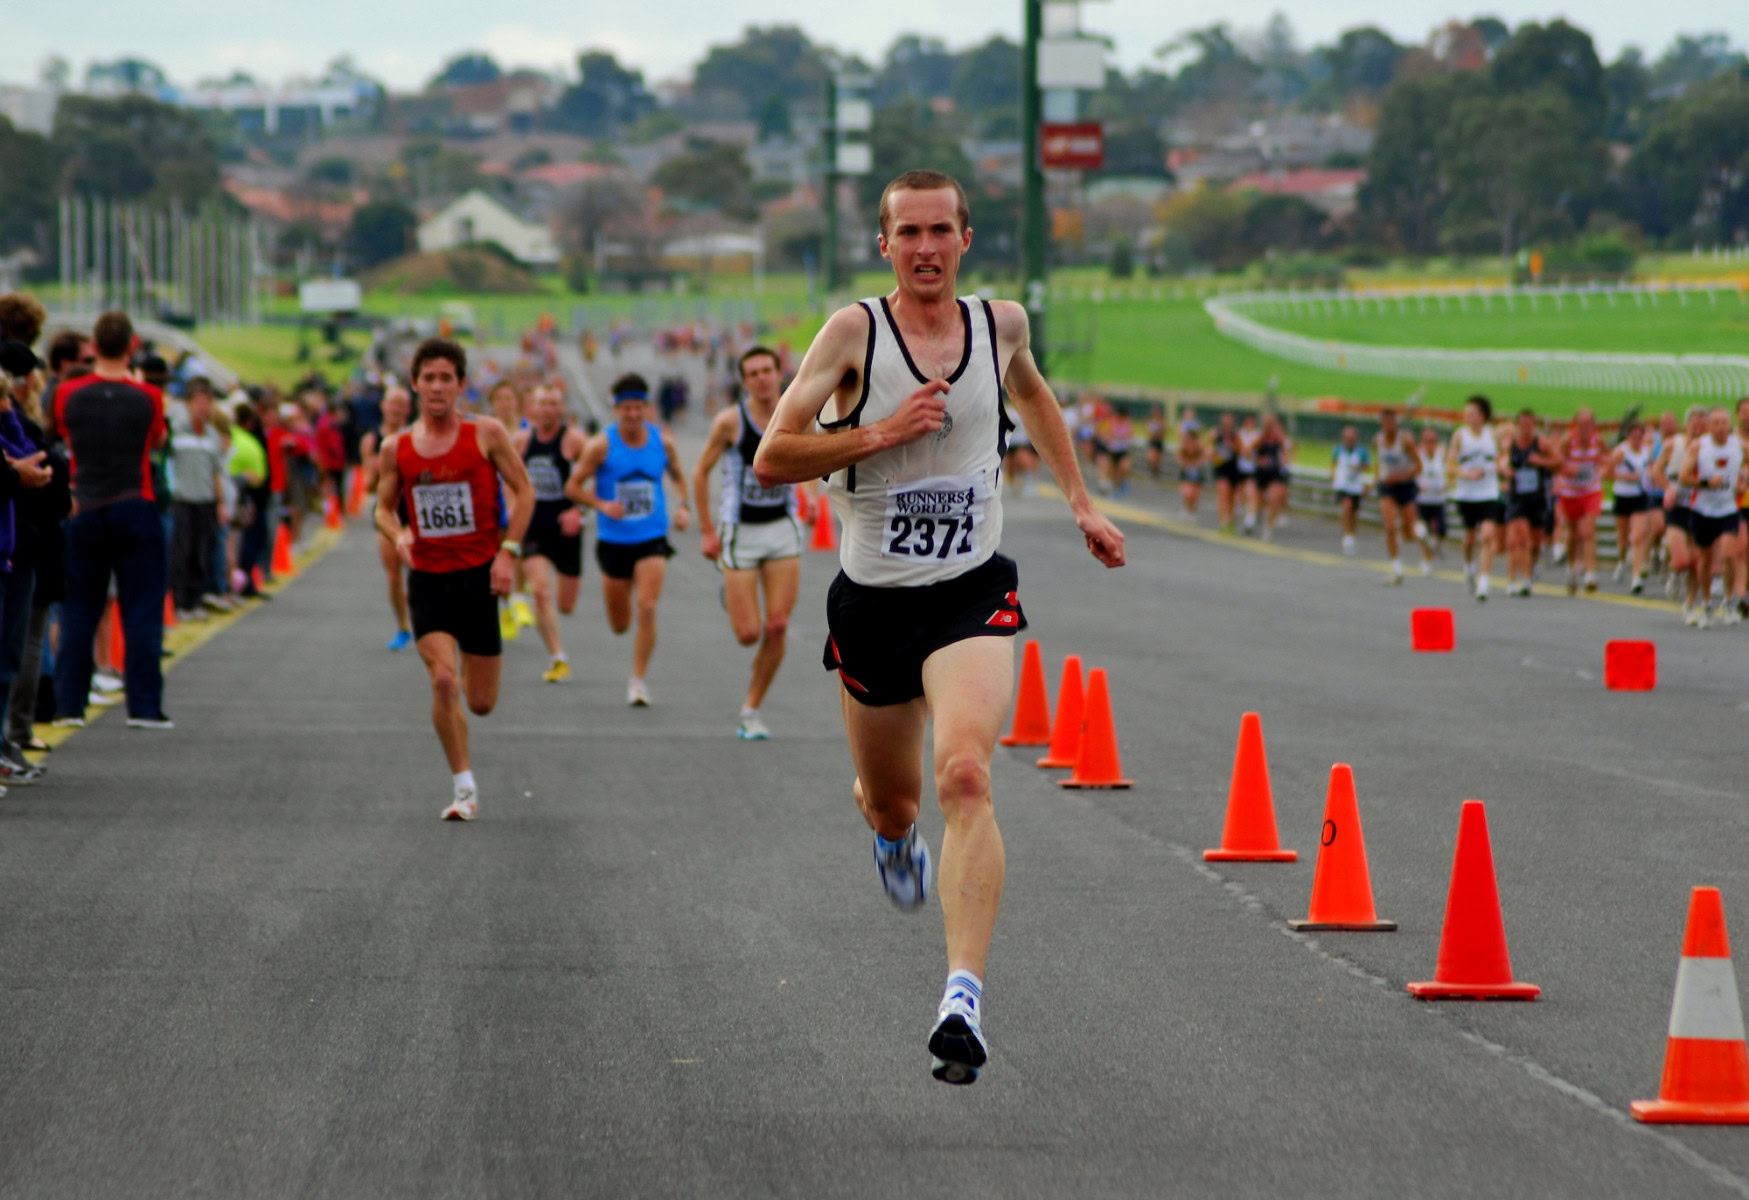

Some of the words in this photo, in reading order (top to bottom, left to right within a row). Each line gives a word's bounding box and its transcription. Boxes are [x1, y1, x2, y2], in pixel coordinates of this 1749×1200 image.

[896, 491, 964, 505] RUNNERS
[421, 505, 470, 530] 1661
[897, 502, 951, 514] WORLD
[889, 515, 974, 559] 2371
